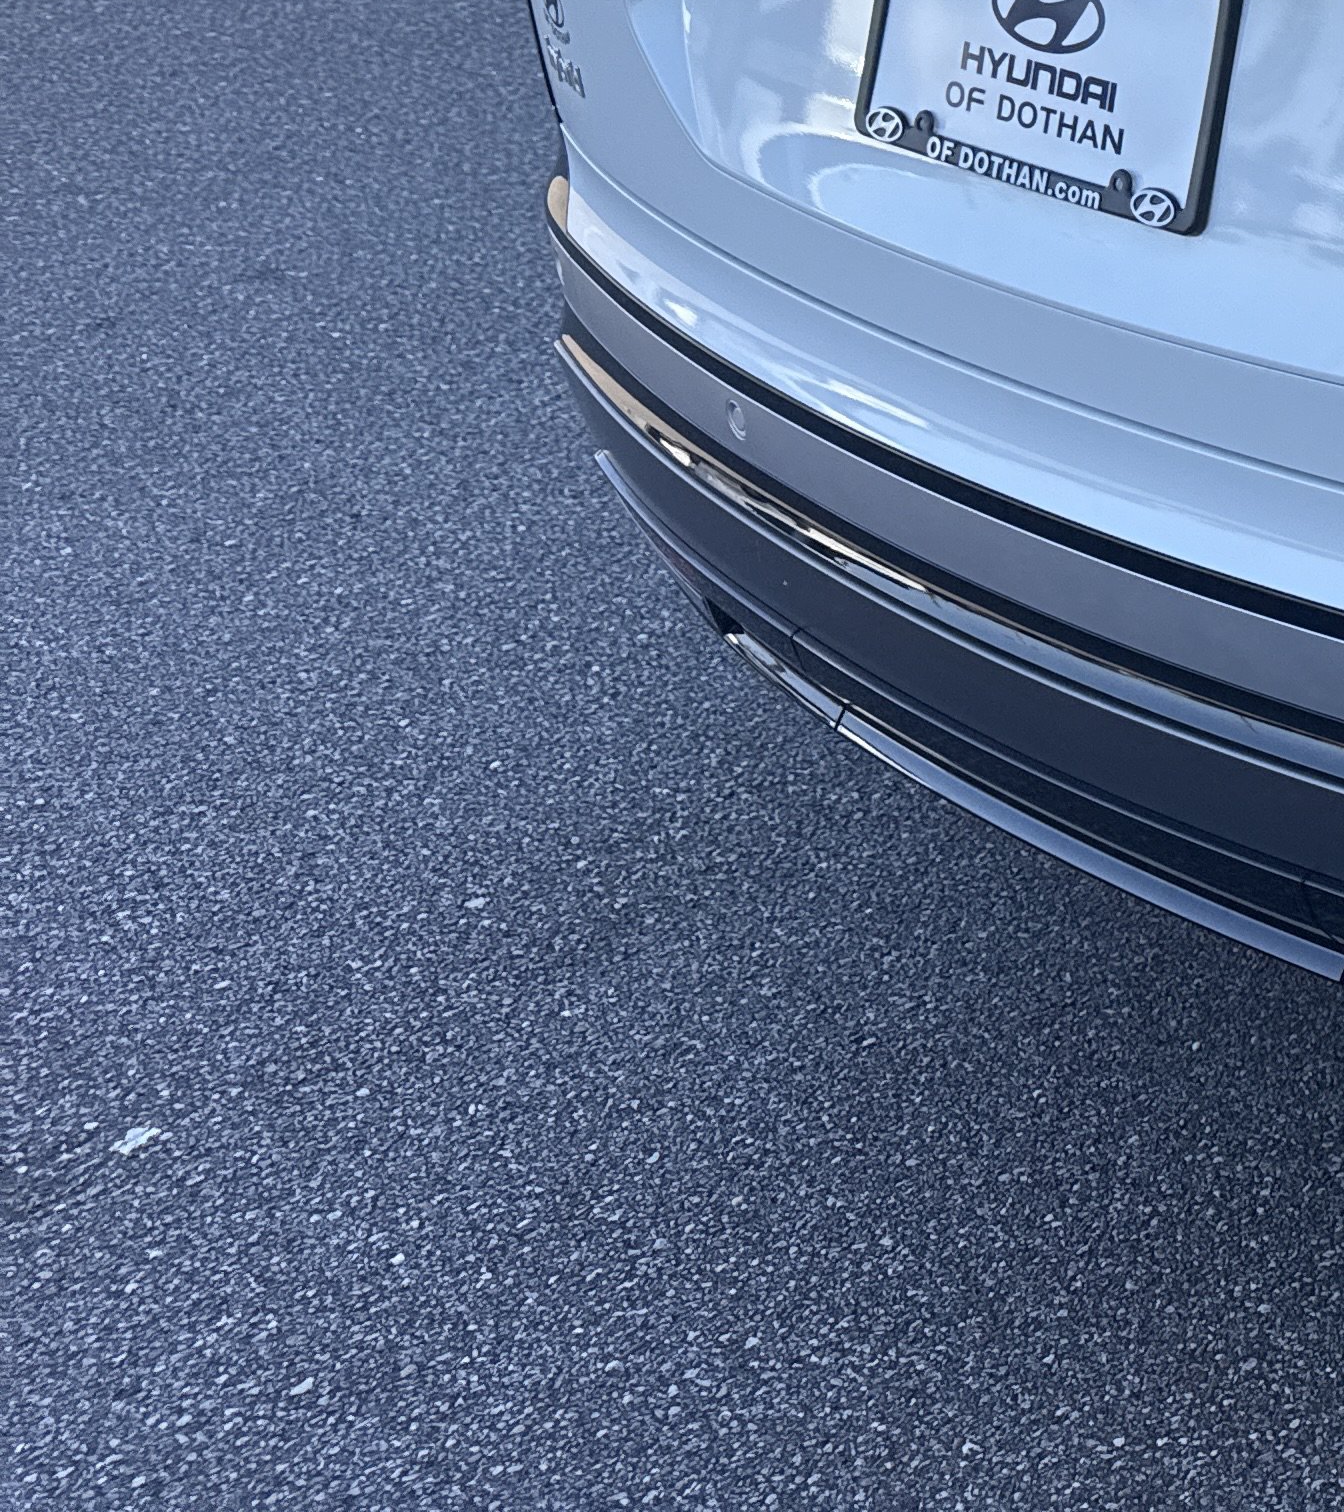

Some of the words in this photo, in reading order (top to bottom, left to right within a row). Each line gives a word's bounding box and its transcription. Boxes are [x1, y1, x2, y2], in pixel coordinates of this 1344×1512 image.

[961, 41, 1118, 113] HYUNDAI
[945, 80, 986, 112] OF
[996, 94, 1125, 155] DOTHAN
[926, 135, 956, 162] OF
[958, 147, 1102, 210] DOTHAN.com
